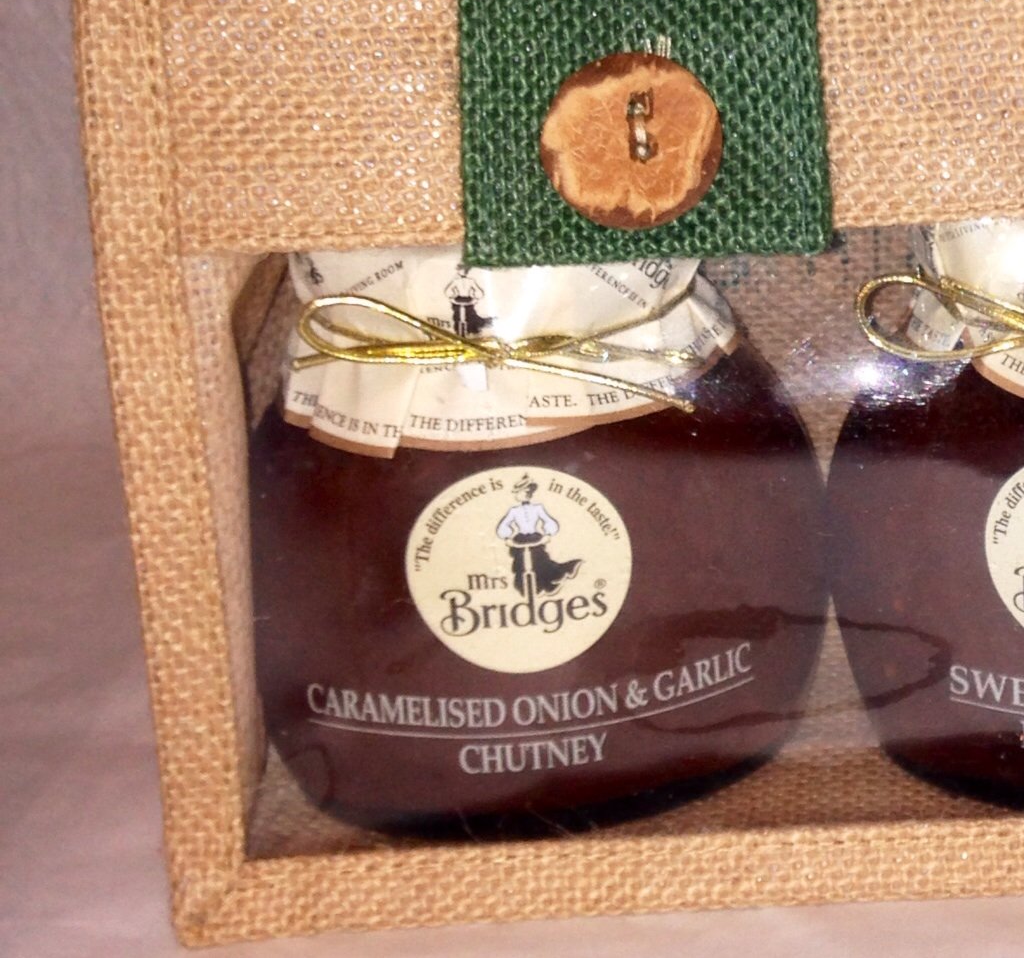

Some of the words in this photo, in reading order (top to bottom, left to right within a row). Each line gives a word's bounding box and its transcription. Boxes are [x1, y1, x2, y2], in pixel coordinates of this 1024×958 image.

[374, 260, 404, 282] ROOM
[527, 393, 578, 409] ASTE.
[587, 391, 620, 406] THE
[361, 421, 379, 436] IN
[411, 413, 443, 432] THE
[547, 478, 565, 495] in
[565, 485, 589, 508] the
[426, 482, 488, 536] difference
[489, 477, 505, 492] is
[467, 572, 510, 591] mrs
[306, 681, 508, 730] CARAMELISED
[512, 684, 619, 728] ONION
[625, 677, 649, 710] &
[652, 641, 754, 702] GARLIC
[458, 732, 608, 776] CHUTNEY
